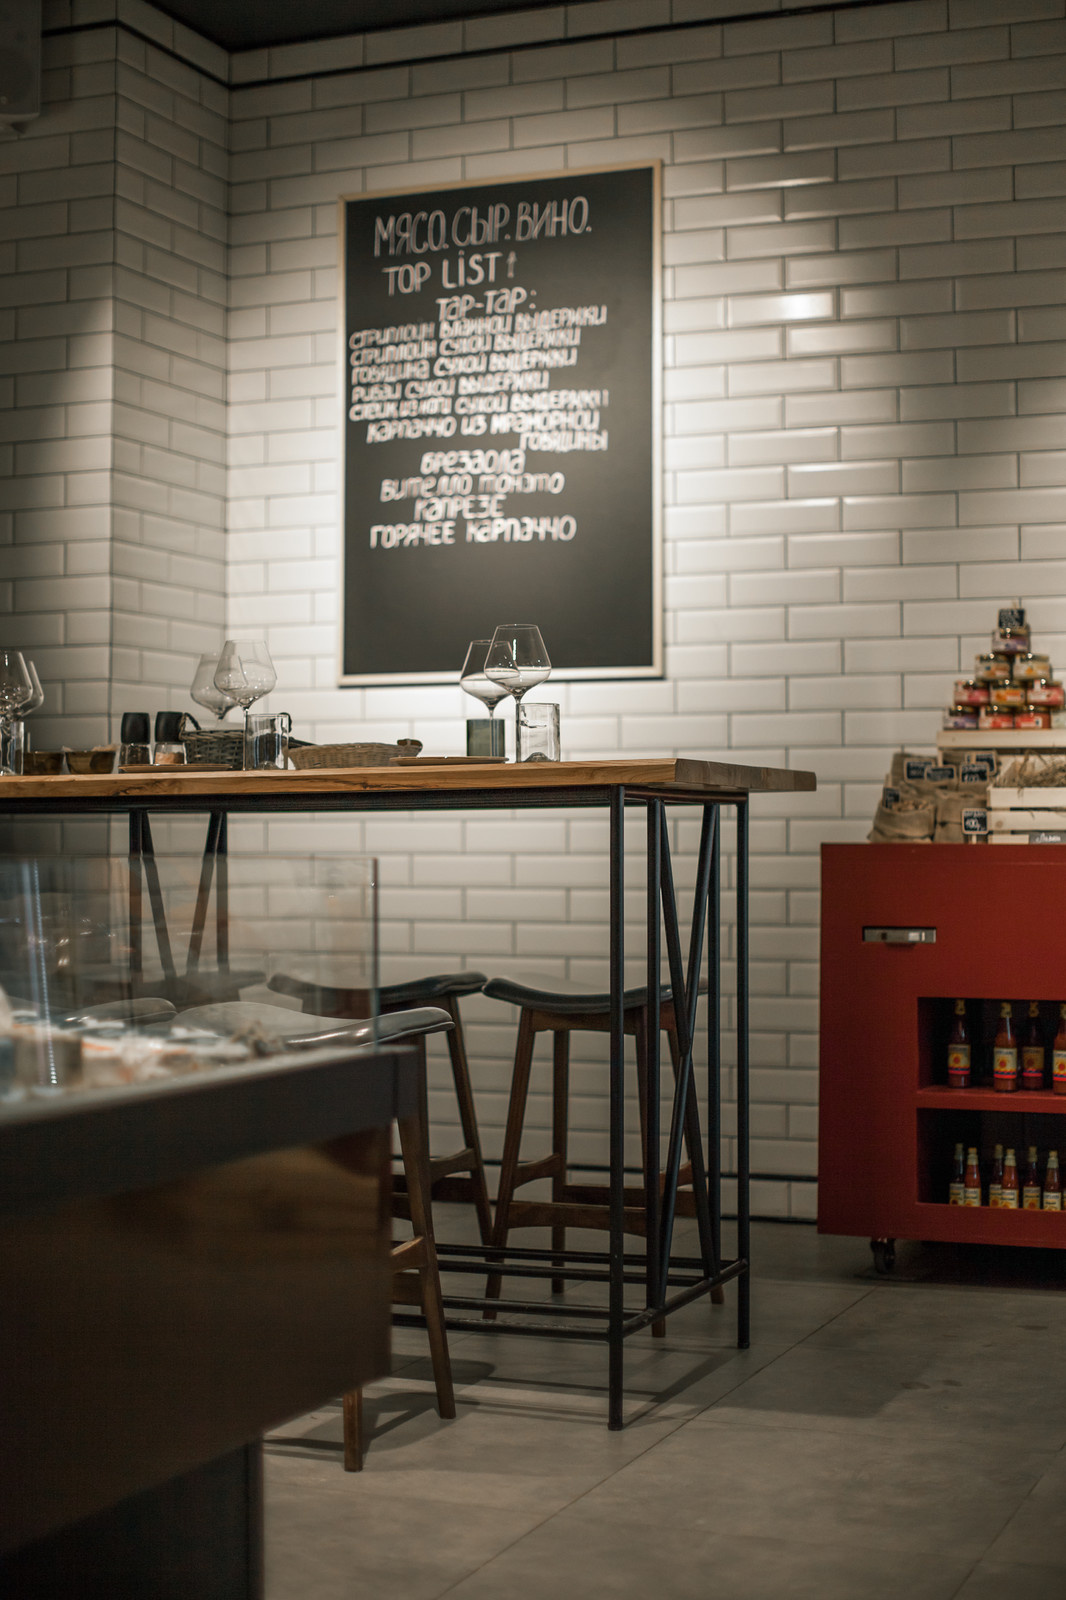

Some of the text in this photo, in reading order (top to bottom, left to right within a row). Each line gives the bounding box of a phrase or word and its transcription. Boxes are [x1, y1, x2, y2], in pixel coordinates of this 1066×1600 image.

[374, 197, 592, 257] МЯСО. СЫР. ВИНО.
[382, 262, 431, 296] TOP
